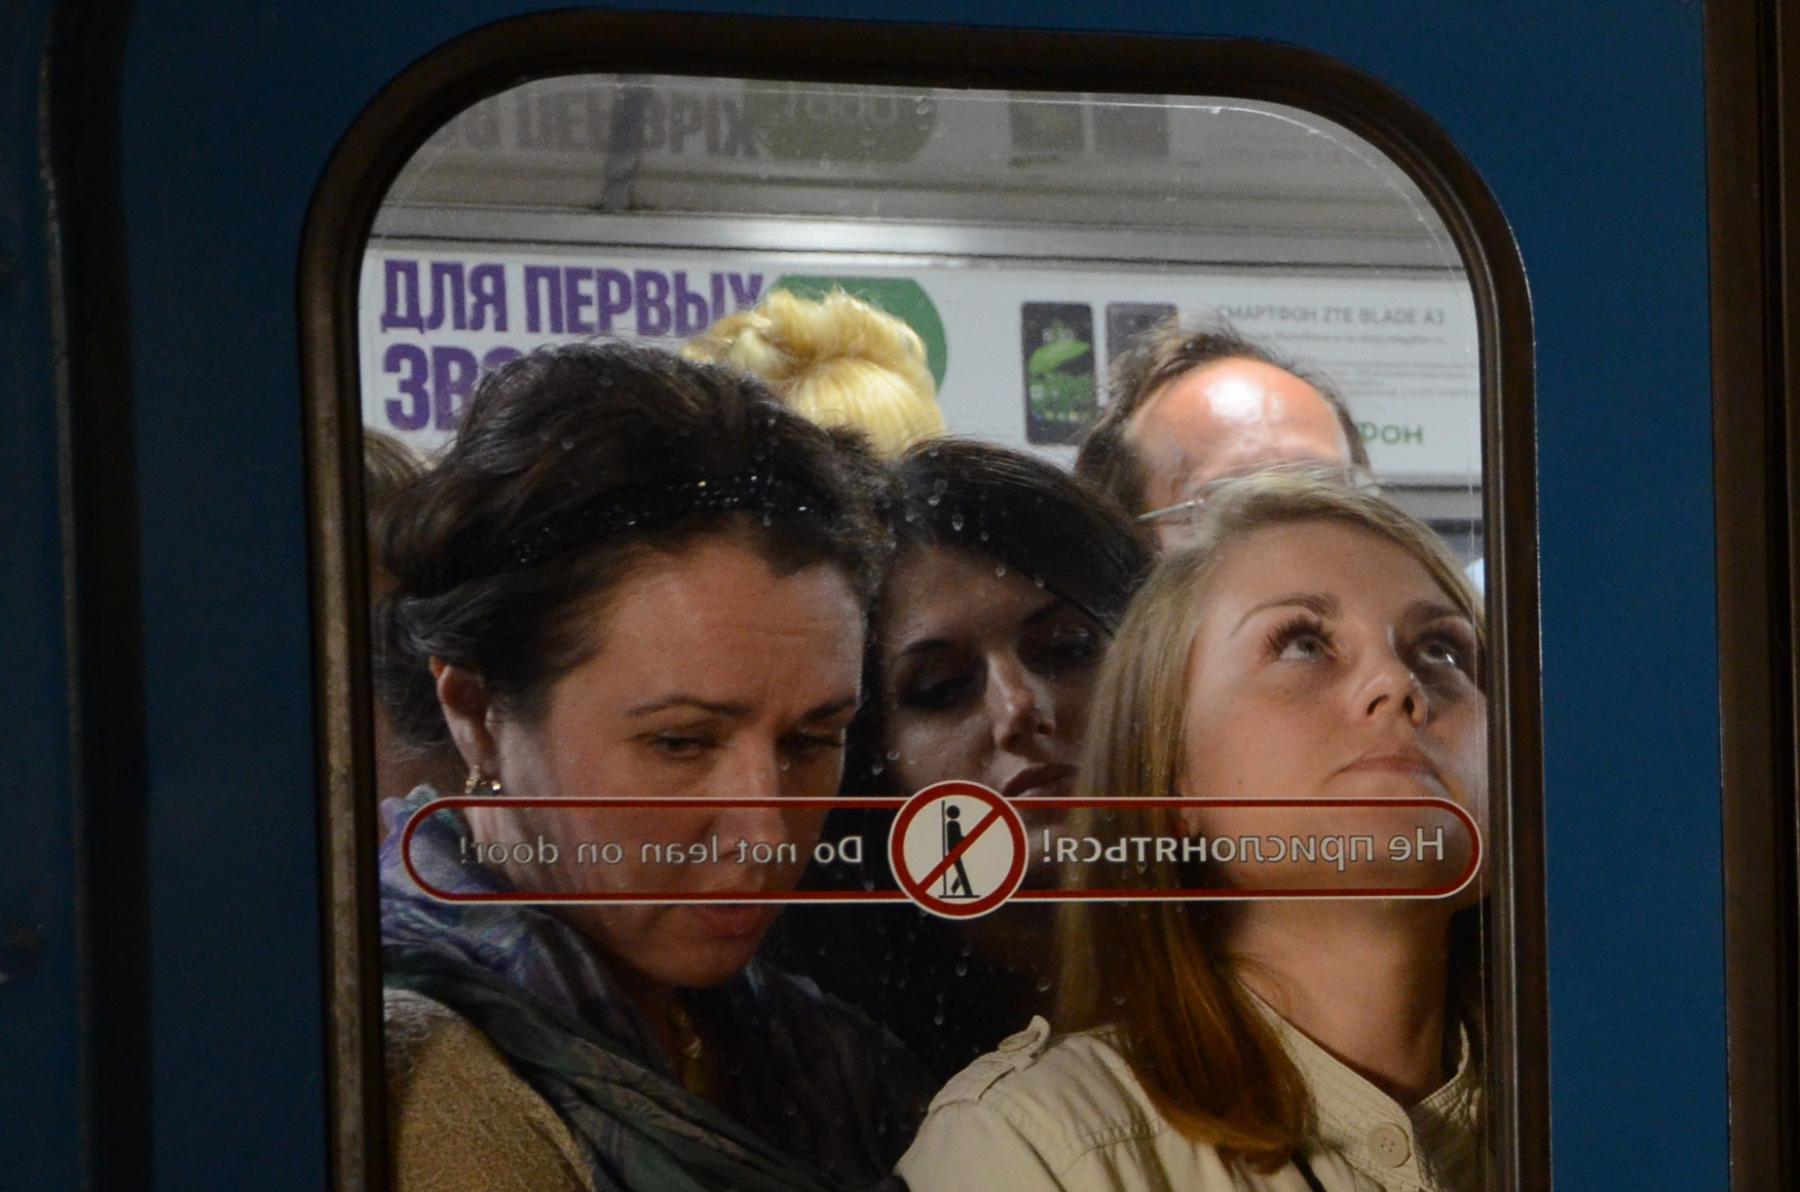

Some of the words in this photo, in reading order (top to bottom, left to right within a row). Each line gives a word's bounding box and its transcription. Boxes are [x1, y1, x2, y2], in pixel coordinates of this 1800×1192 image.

[381, 259, 508, 334] ДЛЯ
[1324, 306, 1353, 324] ZTE
[384, 343, 523, 432] ЗВ
